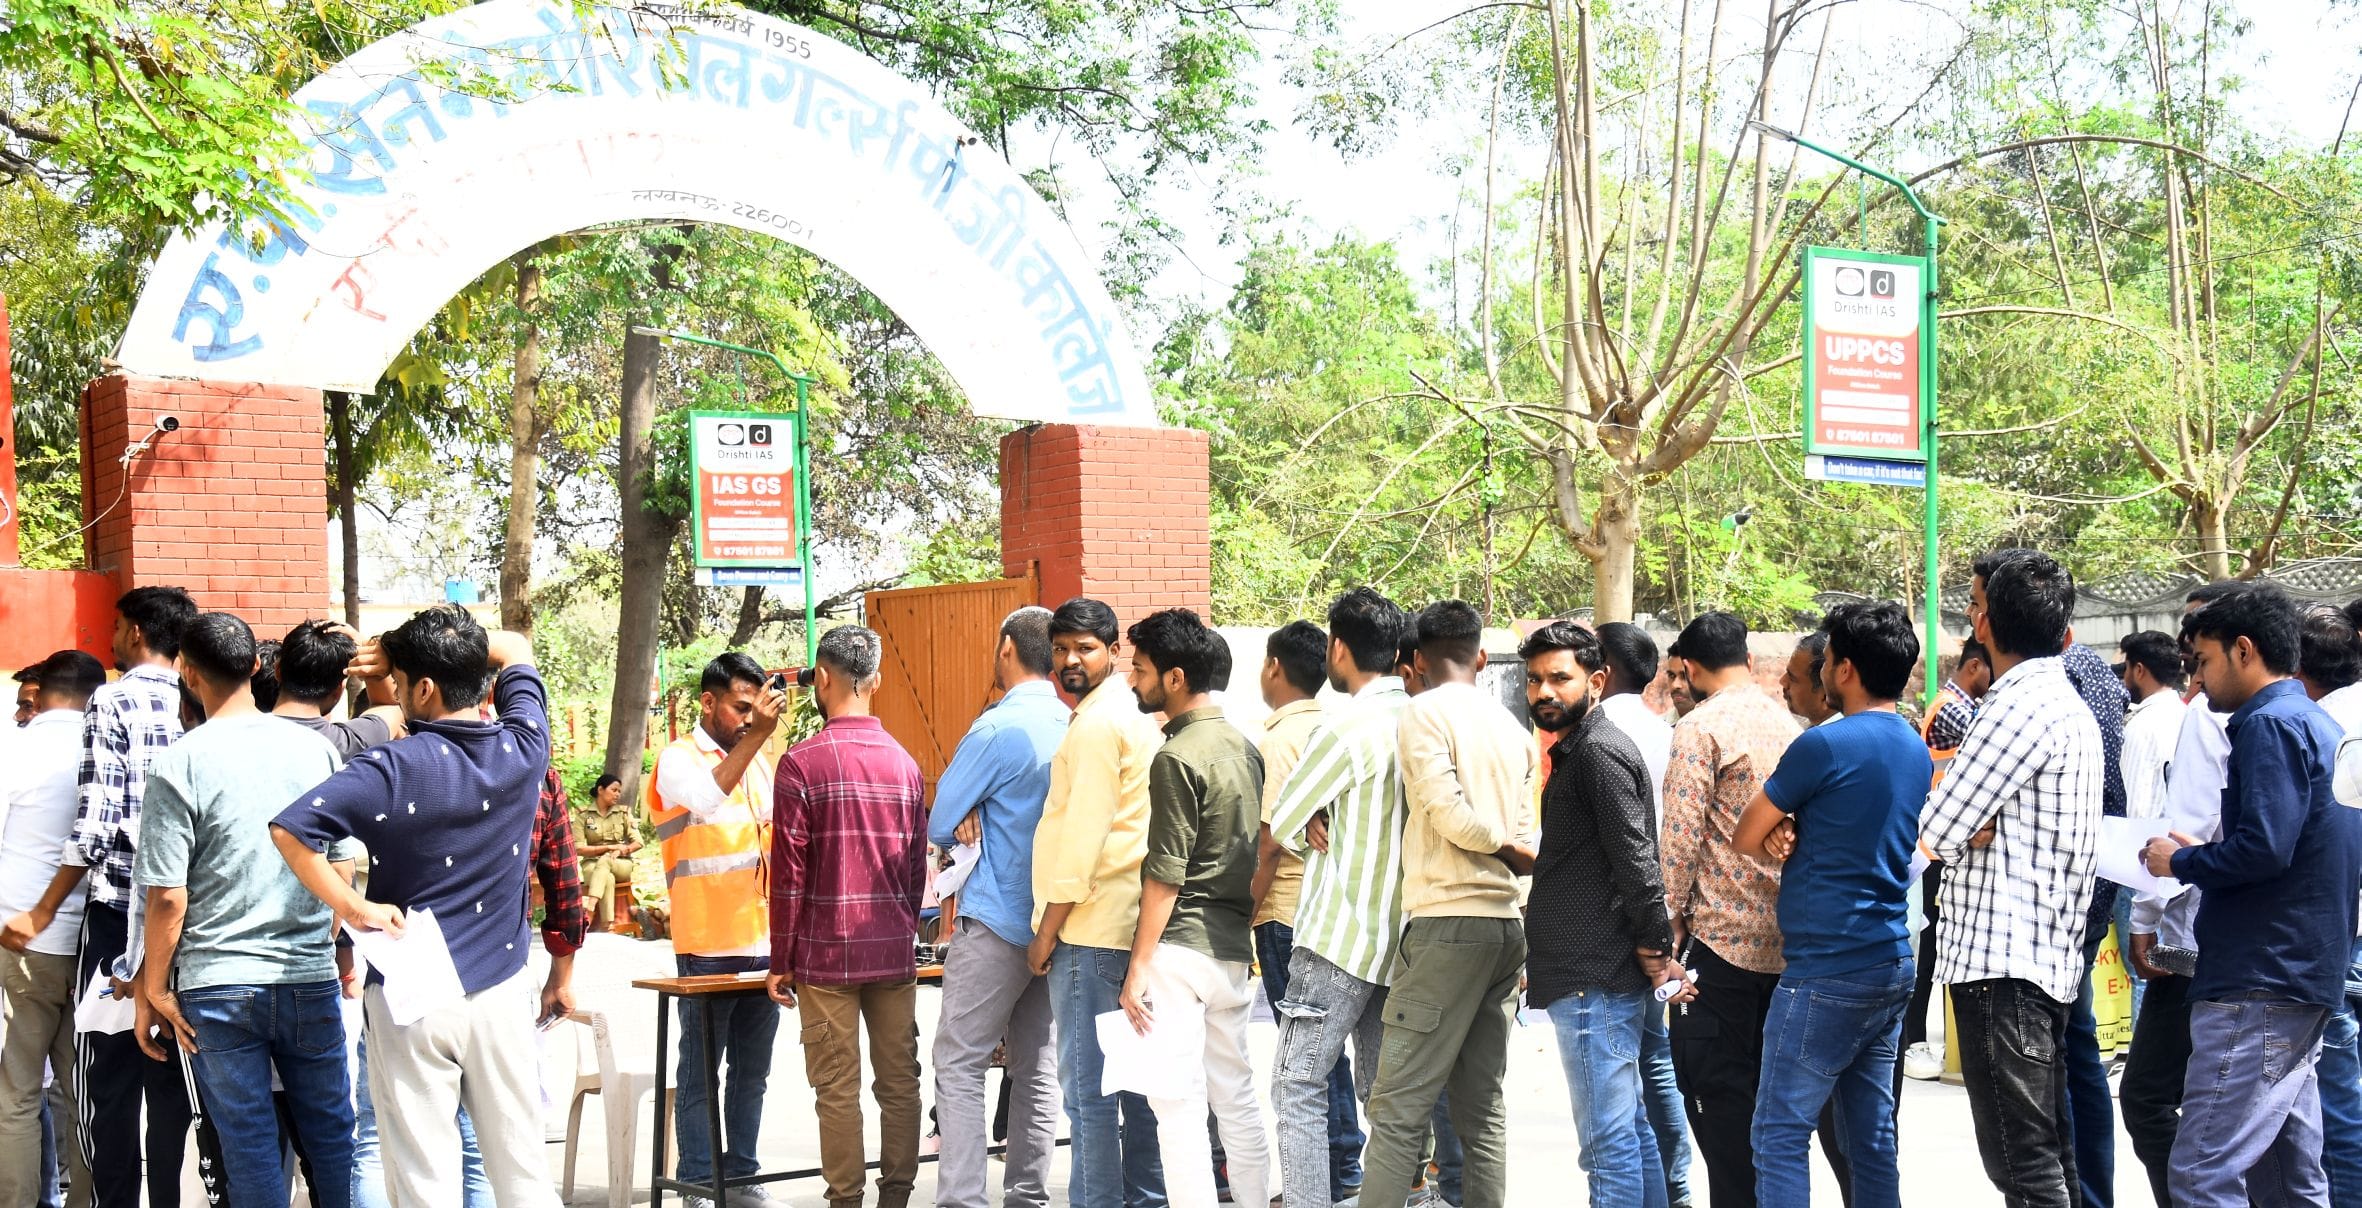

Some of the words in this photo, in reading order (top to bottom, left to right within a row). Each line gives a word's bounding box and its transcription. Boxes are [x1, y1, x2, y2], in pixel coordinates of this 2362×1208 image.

[764, 27, 812, 60] 1955
[1834, 301, 1872, 316] Drishti
[1876, 304, 1896, 318] IAS
[1825, 335, 1905, 366] UPPCS
[1827, 364, 1873, 378] Foundation
[1873, 368, 1903, 380] Course
[718, 449, 752, 460] Drishti
[755, 450, 774, 460] IAS
[712, 476, 748, 495] IAS
[751, 477, 782, 495] GS
[714, 498, 754, 507] Foundation
[755, 499, 781, 507] Course
